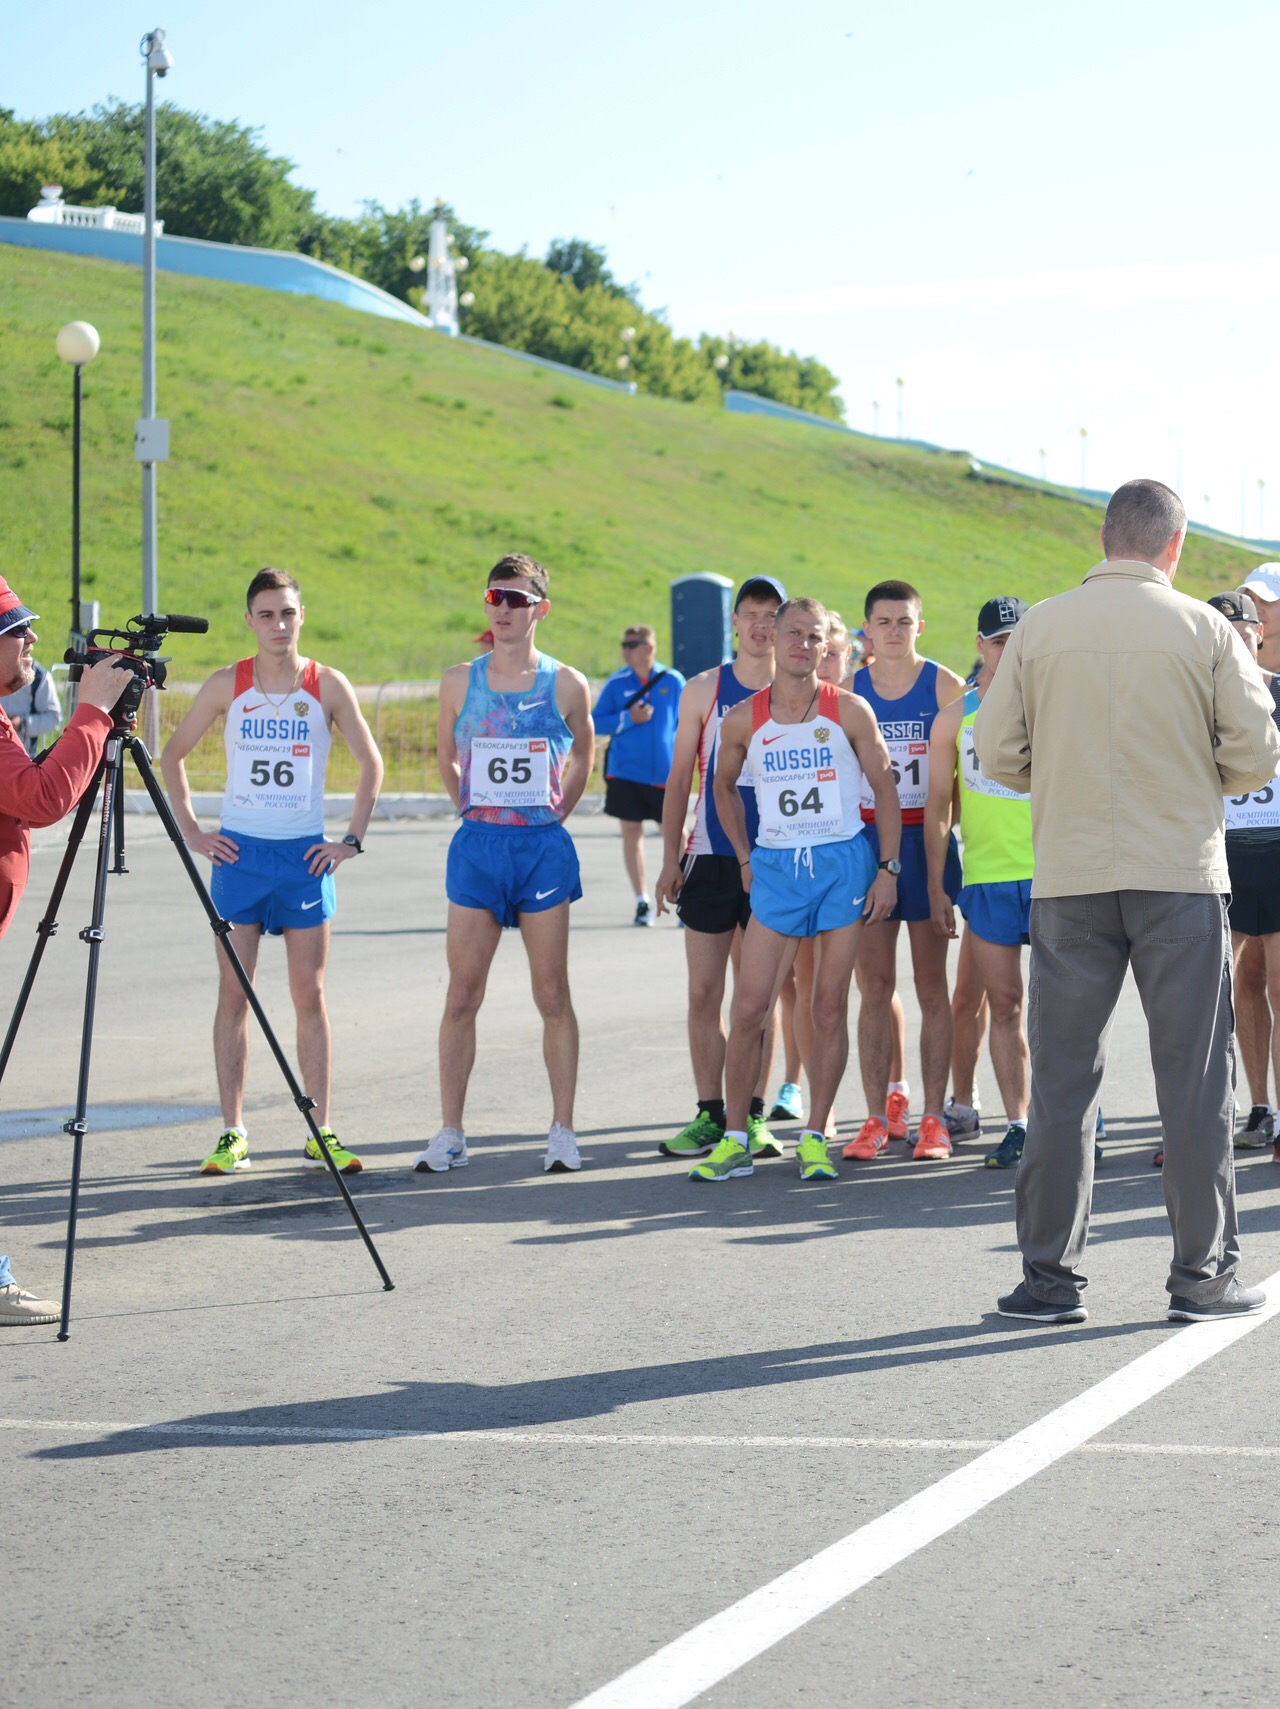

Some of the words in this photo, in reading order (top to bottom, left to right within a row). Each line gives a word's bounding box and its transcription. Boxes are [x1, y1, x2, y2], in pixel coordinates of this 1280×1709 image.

[240, 719, 310, 741] RUSSIA
[488, 757, 532, 784] 65
[763, 747, 833, 773] RUSSIA
[250, 760, 294, 787] 56
[778, 786, 824, 817] 64
[786, 820, 840, 831] ЧЕМПИОНАТ
